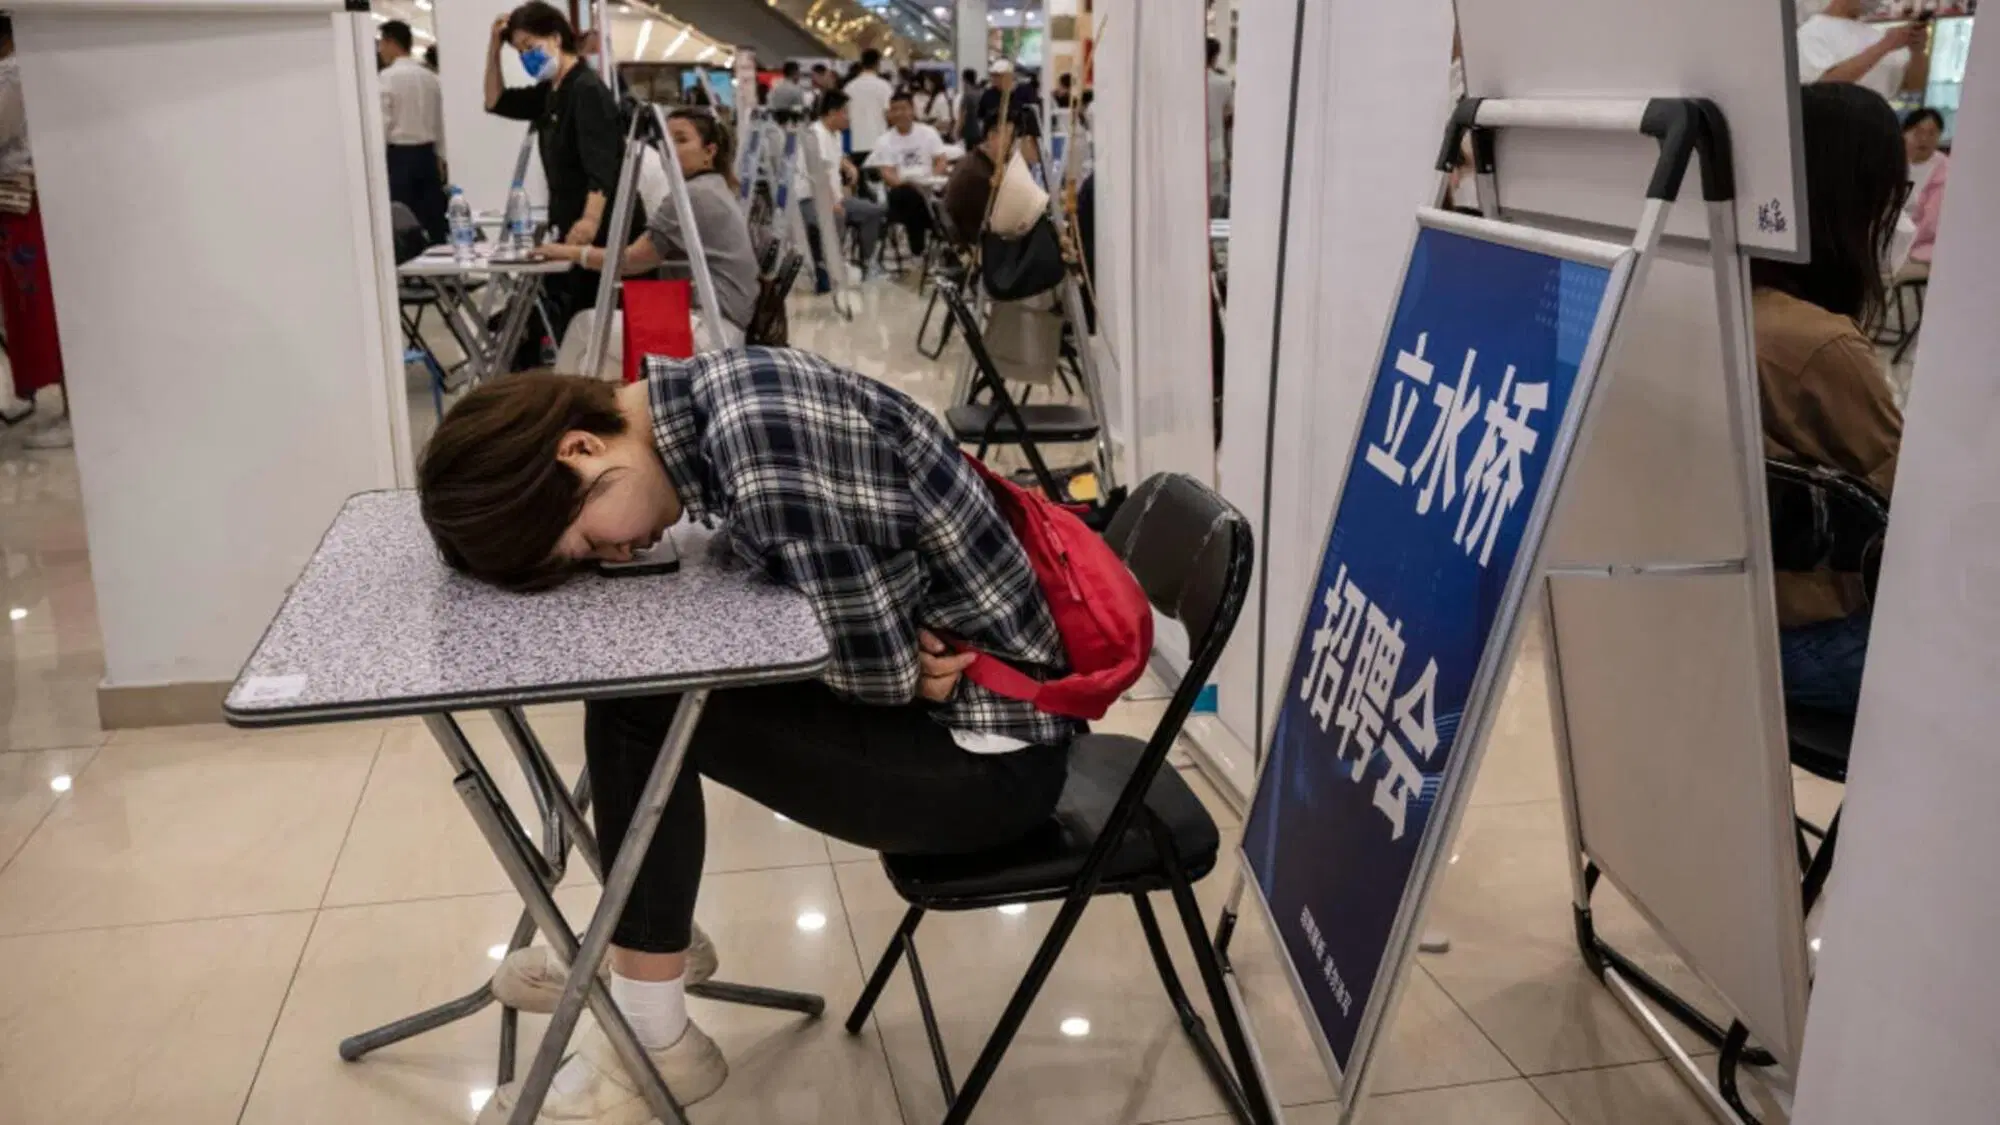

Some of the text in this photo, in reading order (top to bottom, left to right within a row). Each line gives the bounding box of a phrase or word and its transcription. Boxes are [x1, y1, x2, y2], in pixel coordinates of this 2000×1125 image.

[1365, 331, 1549, 568] 立水桥
[1299, 562, 1439, 841] 招聘会
